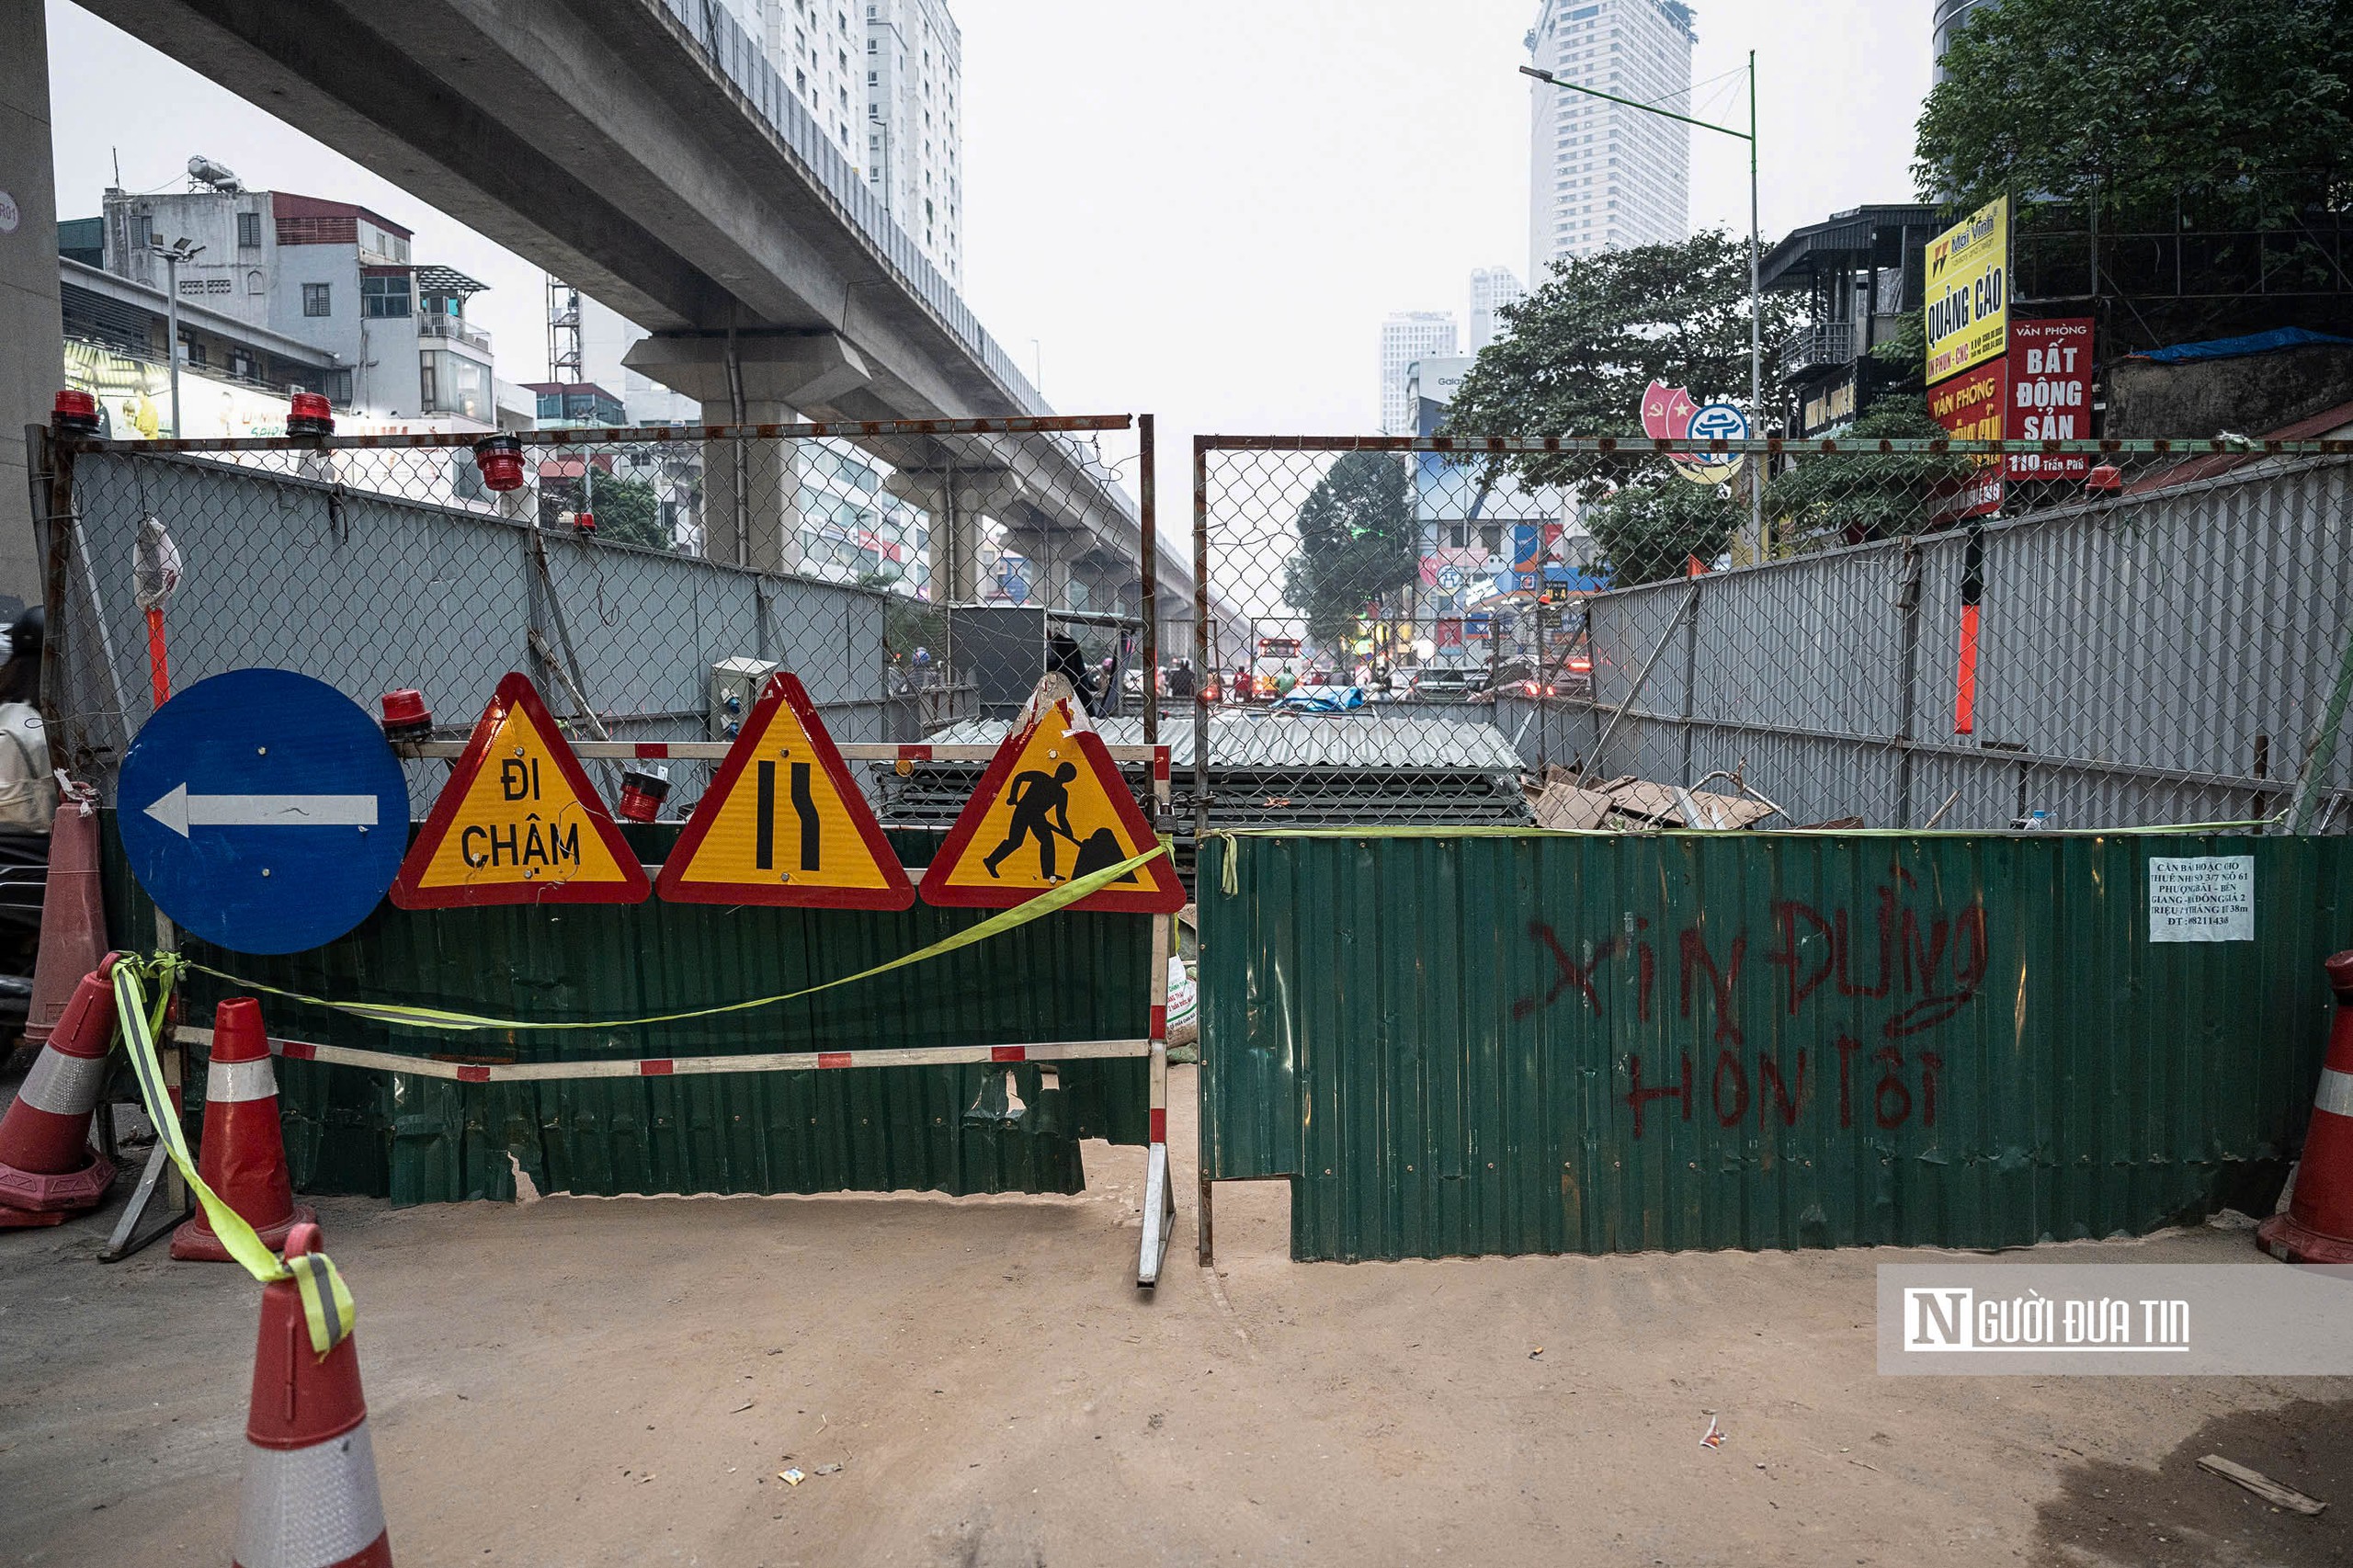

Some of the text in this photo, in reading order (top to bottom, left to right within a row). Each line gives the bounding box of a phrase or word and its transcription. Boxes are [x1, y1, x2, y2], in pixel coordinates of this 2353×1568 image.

[1927, 263, 2003, 349] QUẢNG CÁO
[2016, 324, 2040, 336] VĂN
[2045, 323, 2087, 335] PHÒNG
[2027, 337, 2077, 374] BẤT
[1933, 377, 1995, 419] VĂN PHÒNG
[2016, 376, 2083, 413] ĐỘNG
[2024, 406, 2075, 441] SẢN
[2008, 454, 2040, 472] 110
[500, 757, 540, 801] ĐI
[460, 812, 581, 874] CHẬM
[2238, 872, 2248, 881] 61
[2240, 893, 2246, 902] 2
